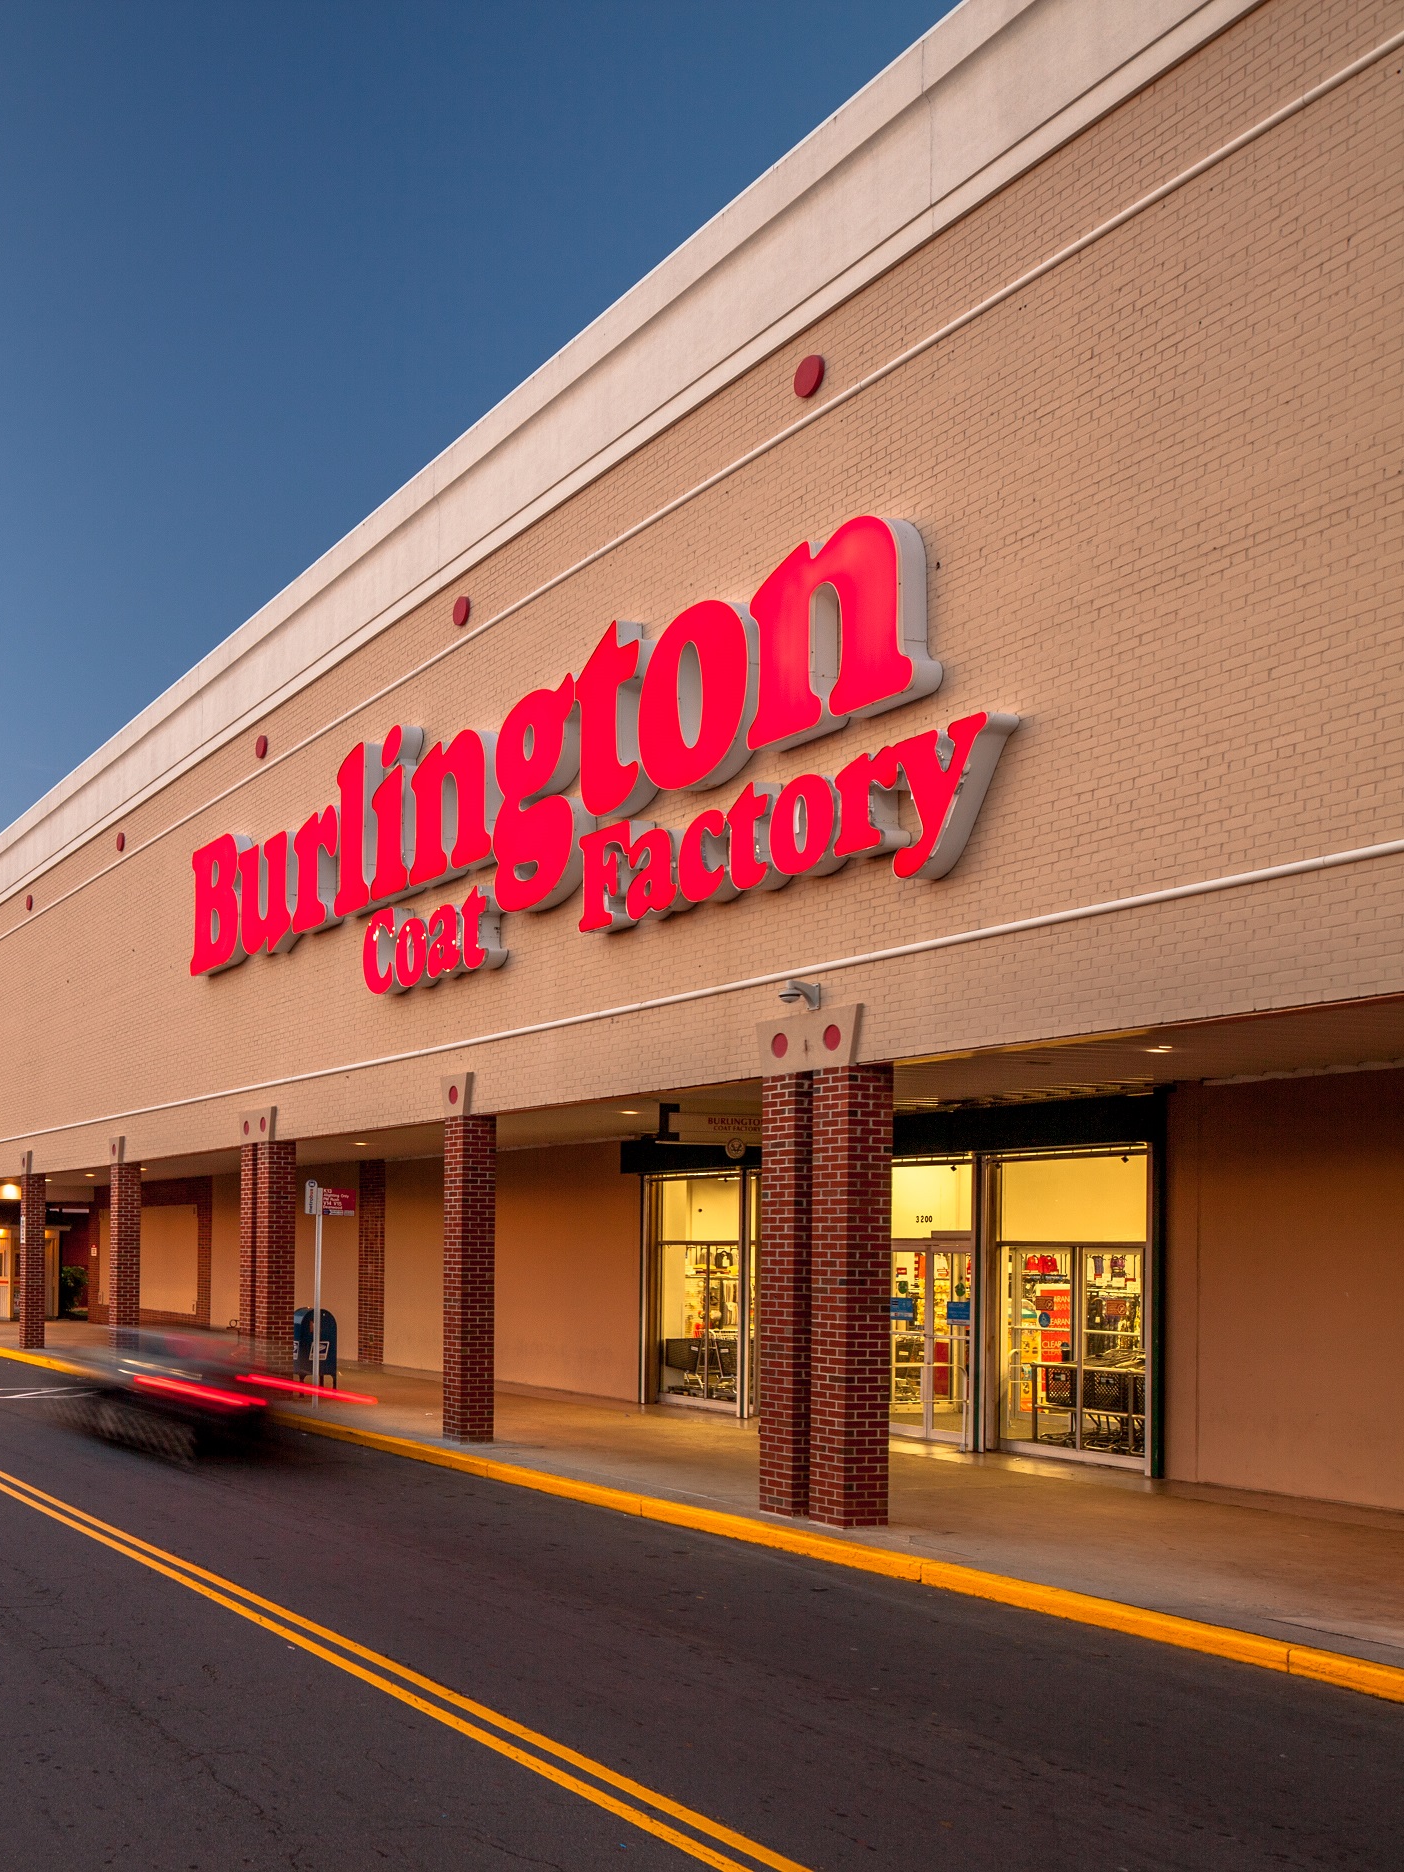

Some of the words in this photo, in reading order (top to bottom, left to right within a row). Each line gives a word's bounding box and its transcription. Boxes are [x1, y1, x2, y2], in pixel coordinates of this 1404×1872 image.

[190, 514, 914, 976] Burlington
[362, 886, 485, 995] Coat
[578, 711, 988, 934] Factory
[707, 1117, 762, 1126] BURLINGTO
[916, 1215, 933, 1223] 3200
